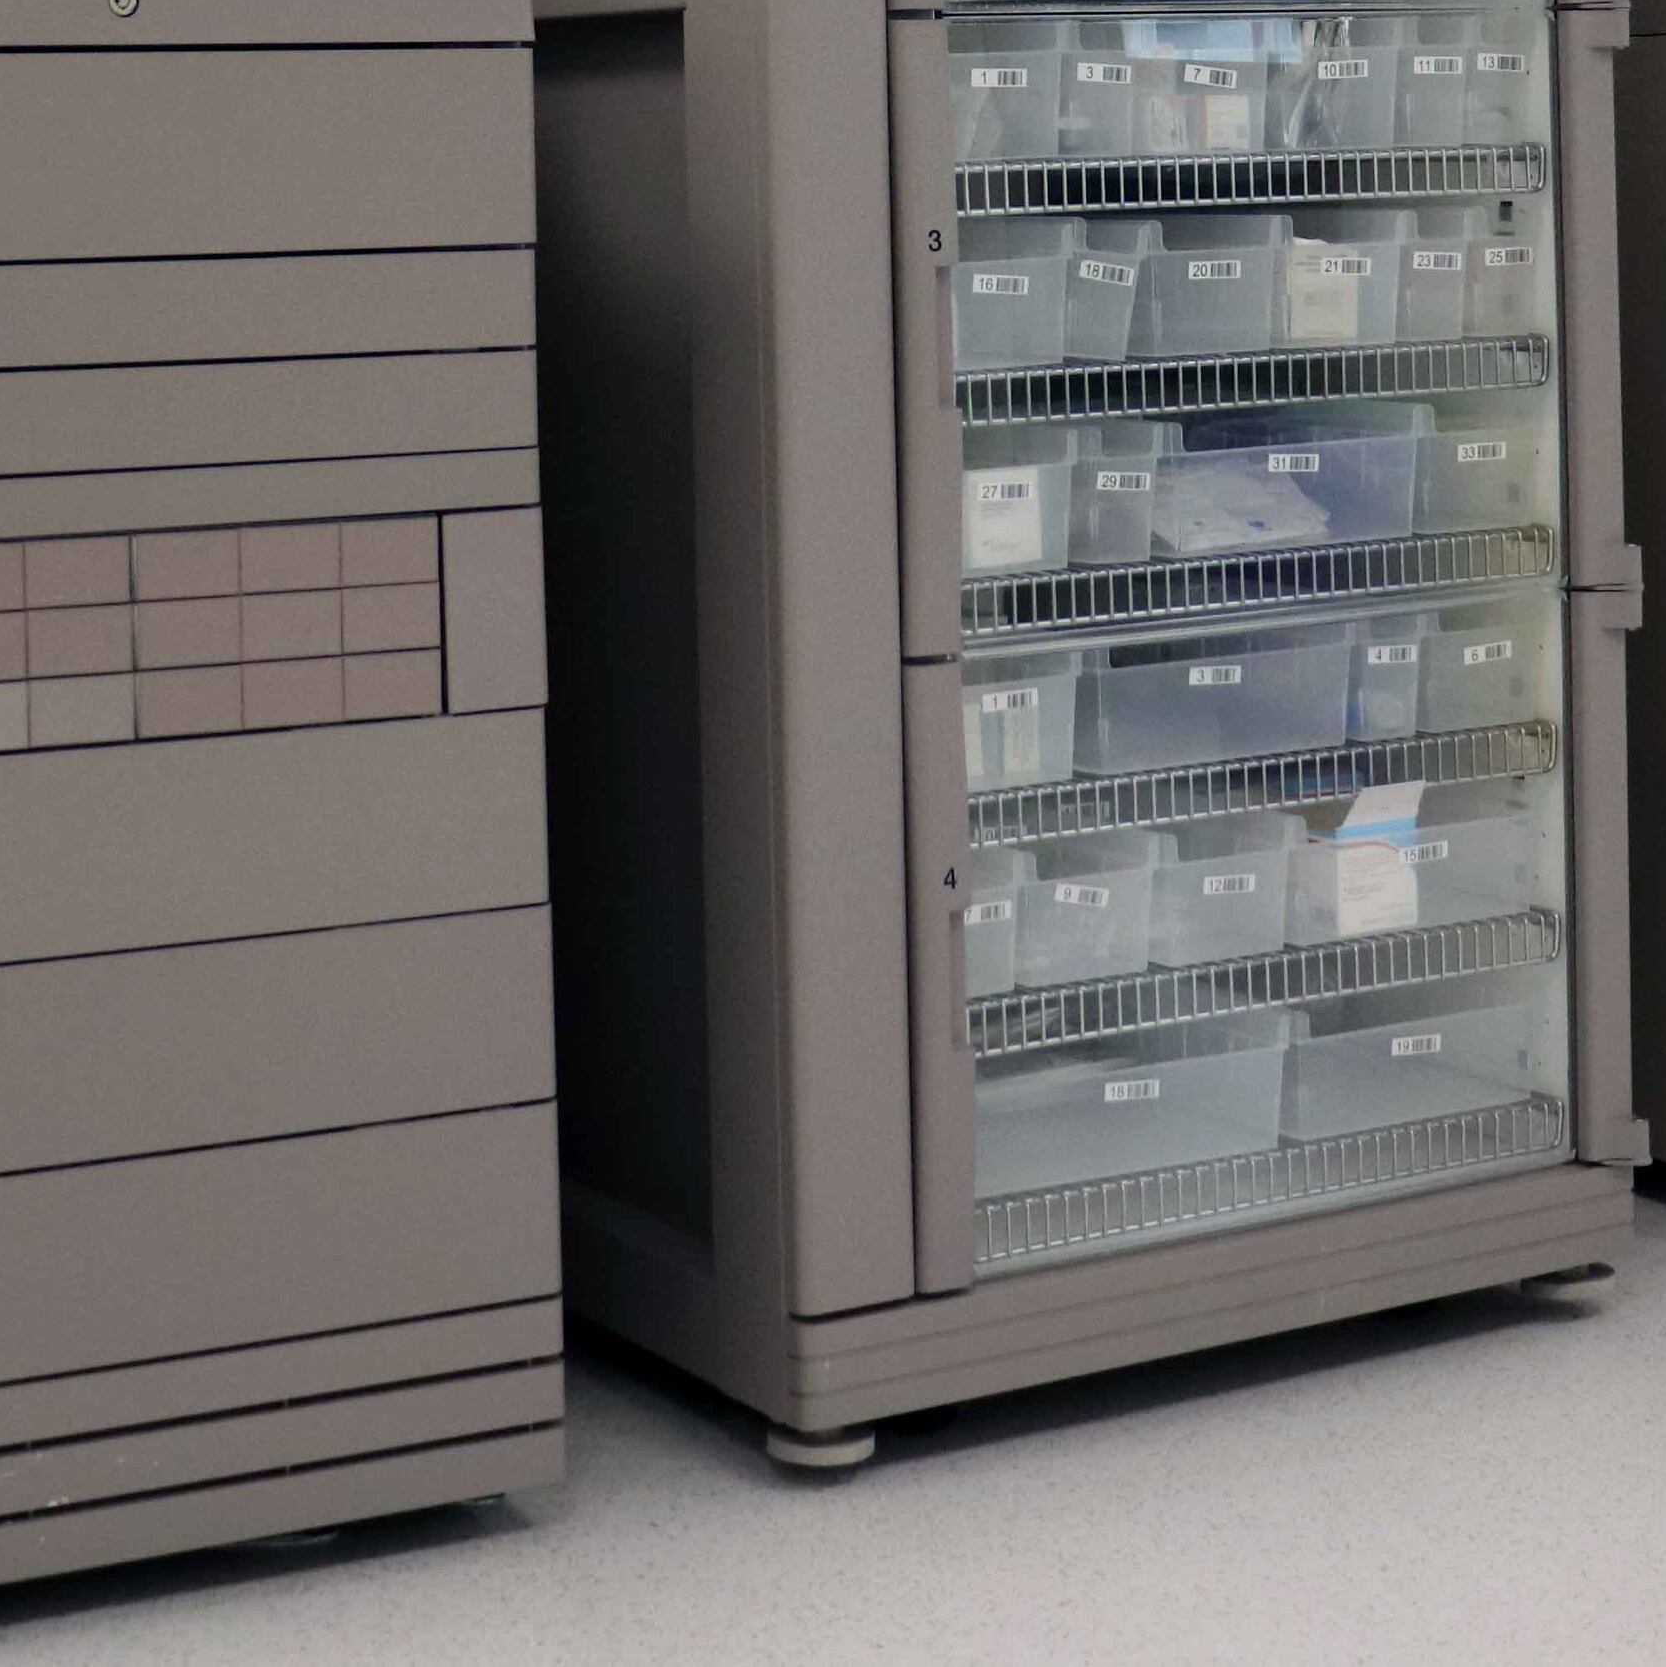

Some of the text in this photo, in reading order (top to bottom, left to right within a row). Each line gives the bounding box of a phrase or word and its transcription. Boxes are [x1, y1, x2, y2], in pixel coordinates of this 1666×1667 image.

[1419, 58, 1432, 71] 11
[1481, 55, 1495, 69] 13
[1085, 66, 1094, 80] 3
[1193, 67, 1201, 81] 7
[1323, 63, 1337, 77] 10
[981, 71, 988, 84] 1
[928, 230, 942, 251] 3
[1417, 254, 1432, 268] 23
[1488, 249, 1503, 263] 25
[1086, 262, 1100, 277] 18
[1193, 262, 1208, 277] 20
[1325, 259, 1340, 273] 21
[978, 277, 994, 291] 16
[1461, 446, 1476, 460] 33
[1272, 455, 1287, 470] 31
[1102, 474, 1118, 489] 29
[982, 484, 998, 499] 27
[1374, 648, 1383, 661] 4
[1470, 647, 1479, 662] 6
[1197, 669, 1205, 682] 3
[991, 695, 999, 708] 1
[1403, 849, 1417, 863] 15
[943, 867, 958, 889] 4
[1208, 878, 1222, 892] 12
[1063, 886, 1072, 899] 9
[966, 909, 974, 922] 7
[1396, 1040, 1410, 1054] 19
[1110, 1084, 1125, 1099] 18
